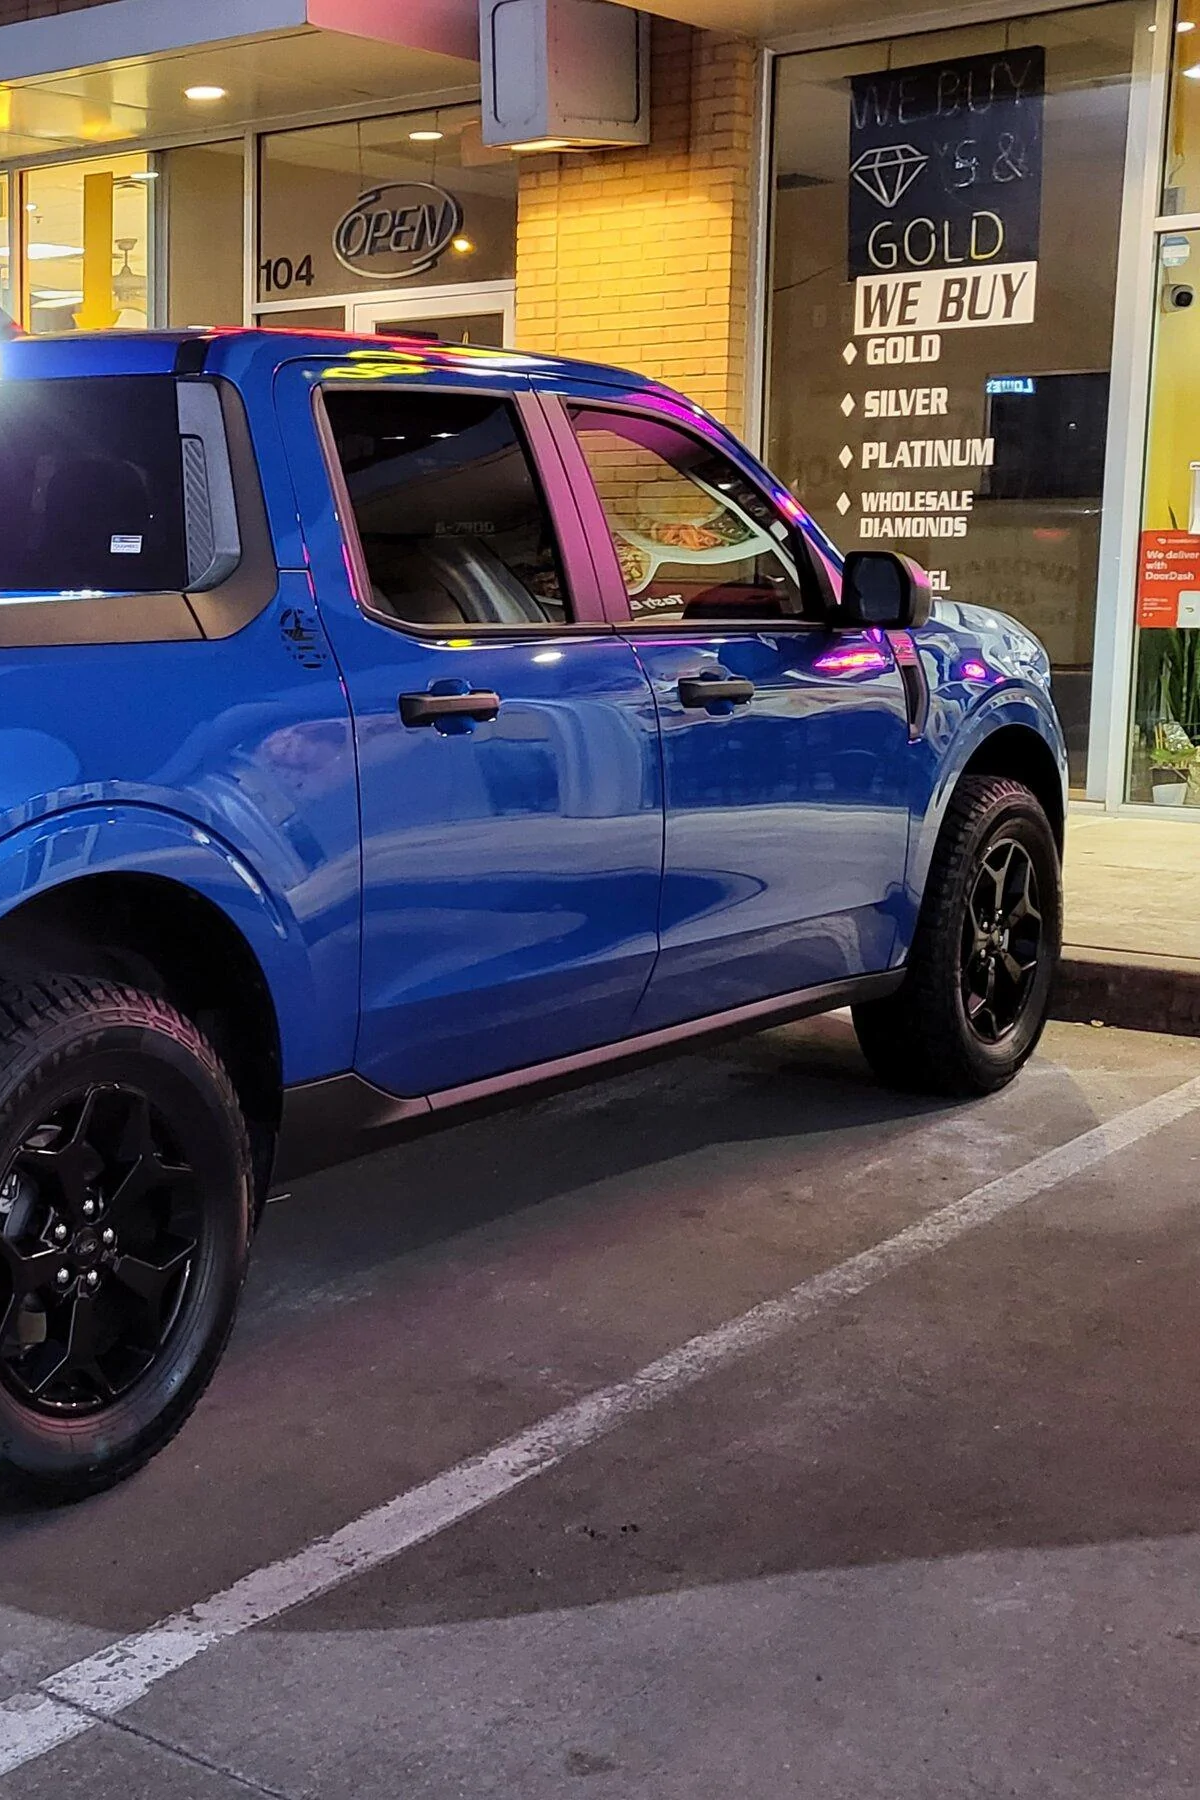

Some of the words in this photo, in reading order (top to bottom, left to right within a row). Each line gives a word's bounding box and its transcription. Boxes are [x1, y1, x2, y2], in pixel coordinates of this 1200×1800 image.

[852, 77, 928, 129] WE
[936, 60, 1032, 116] BUY
[338, 201, 448, 256] OPEN
[868, 211, 1004, 269] GOLD
[261, 255, 314, 291] 104
[862, 280, 922, 329] WE
[937, 271, 1029, 324] BUY
[866, 333, 941, 366] GOLD
[864, 387, 948, 418] SILVER
[861, 438, 995, 469] PLATINUM
[861, 490, 974, 512] WHOLESALE
[859, 516, 968, 538] DIAMONDS
[1145, 561, 1167, 570] with
[1146, 550, 1164, 559] We
[1165, 550, 1200, 559] deliver
[1145, 571, 1195, 581] DoorDash
